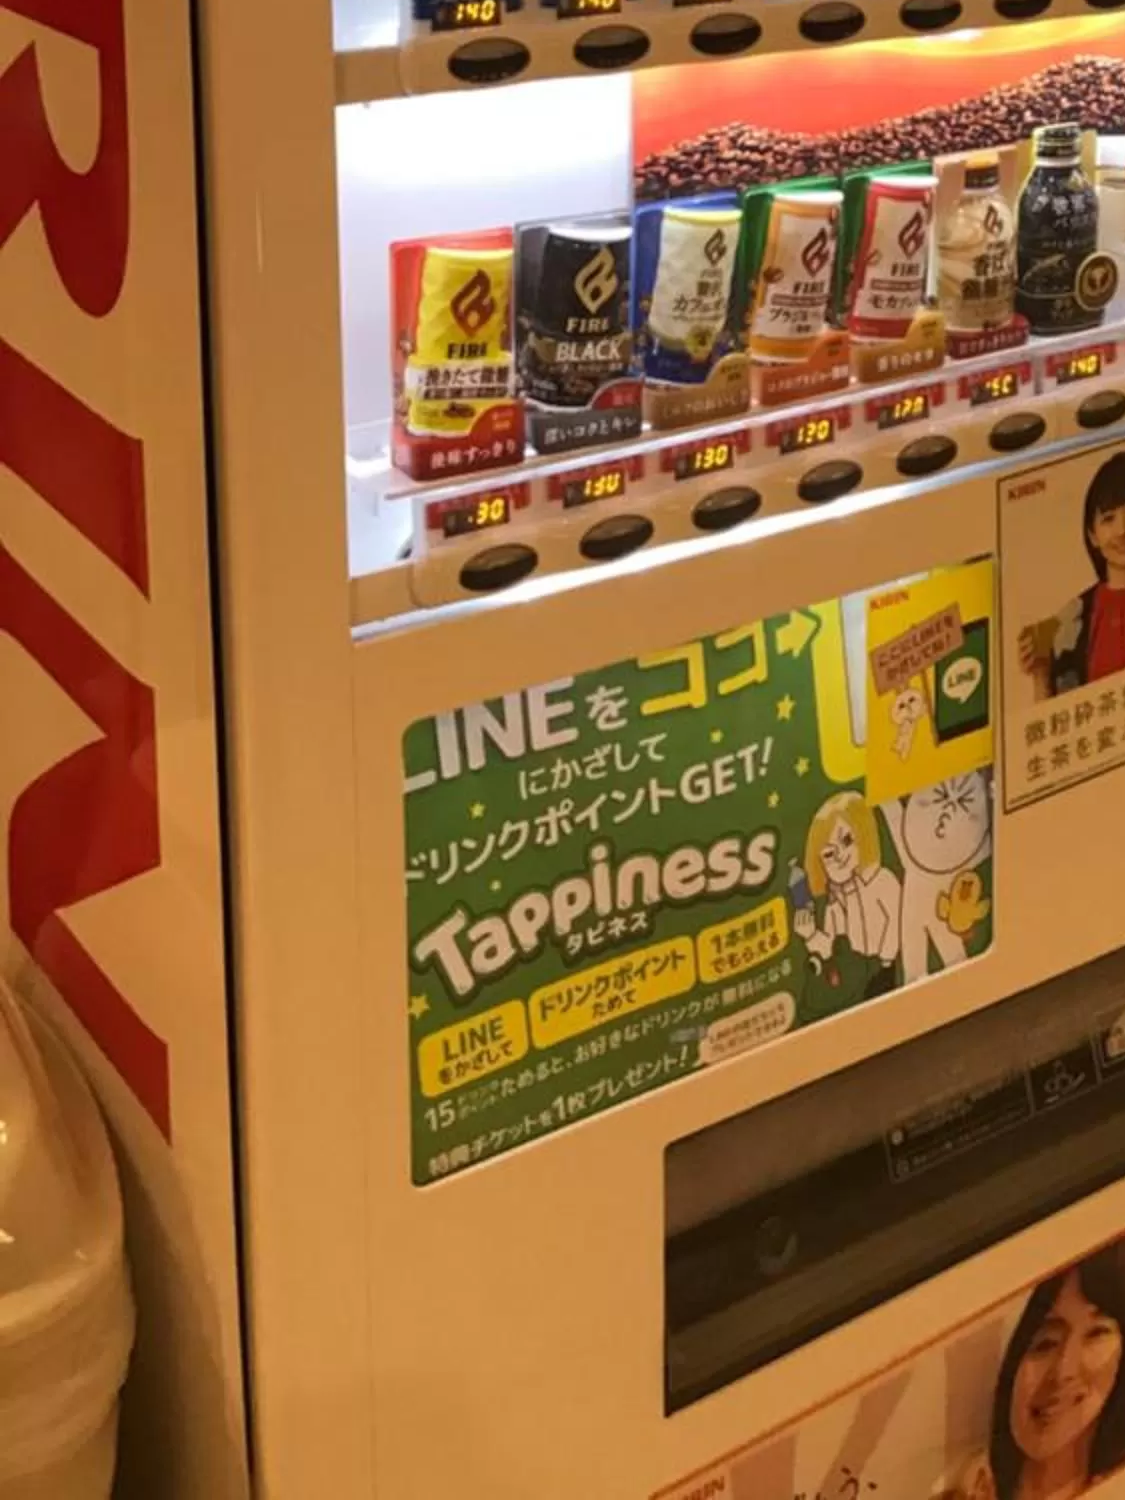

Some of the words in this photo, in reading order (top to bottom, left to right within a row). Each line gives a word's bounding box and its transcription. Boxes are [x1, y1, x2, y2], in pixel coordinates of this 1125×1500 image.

[456, 0, 497, 23] 140
[555, 338, 622, 362] BLACK
[693, 443, 729, 470] 130
[517, 733, 669, 800] にかざして
[413, 829, 776, 997] Tappiness
[710, 912, 777, 954] 1本無料
[566, 913, 649, 957] タピネス
[710, 934, 781, 976] でもらえる
[537, 949, 687, 1021] ドリンクポイント
[591, 990, 637, 1019] ためて
[441, 1016, 505, 1063] LINE
[438, 1041, 515, 1086] をかざして
[423, 1101, 456, 1133] 15
